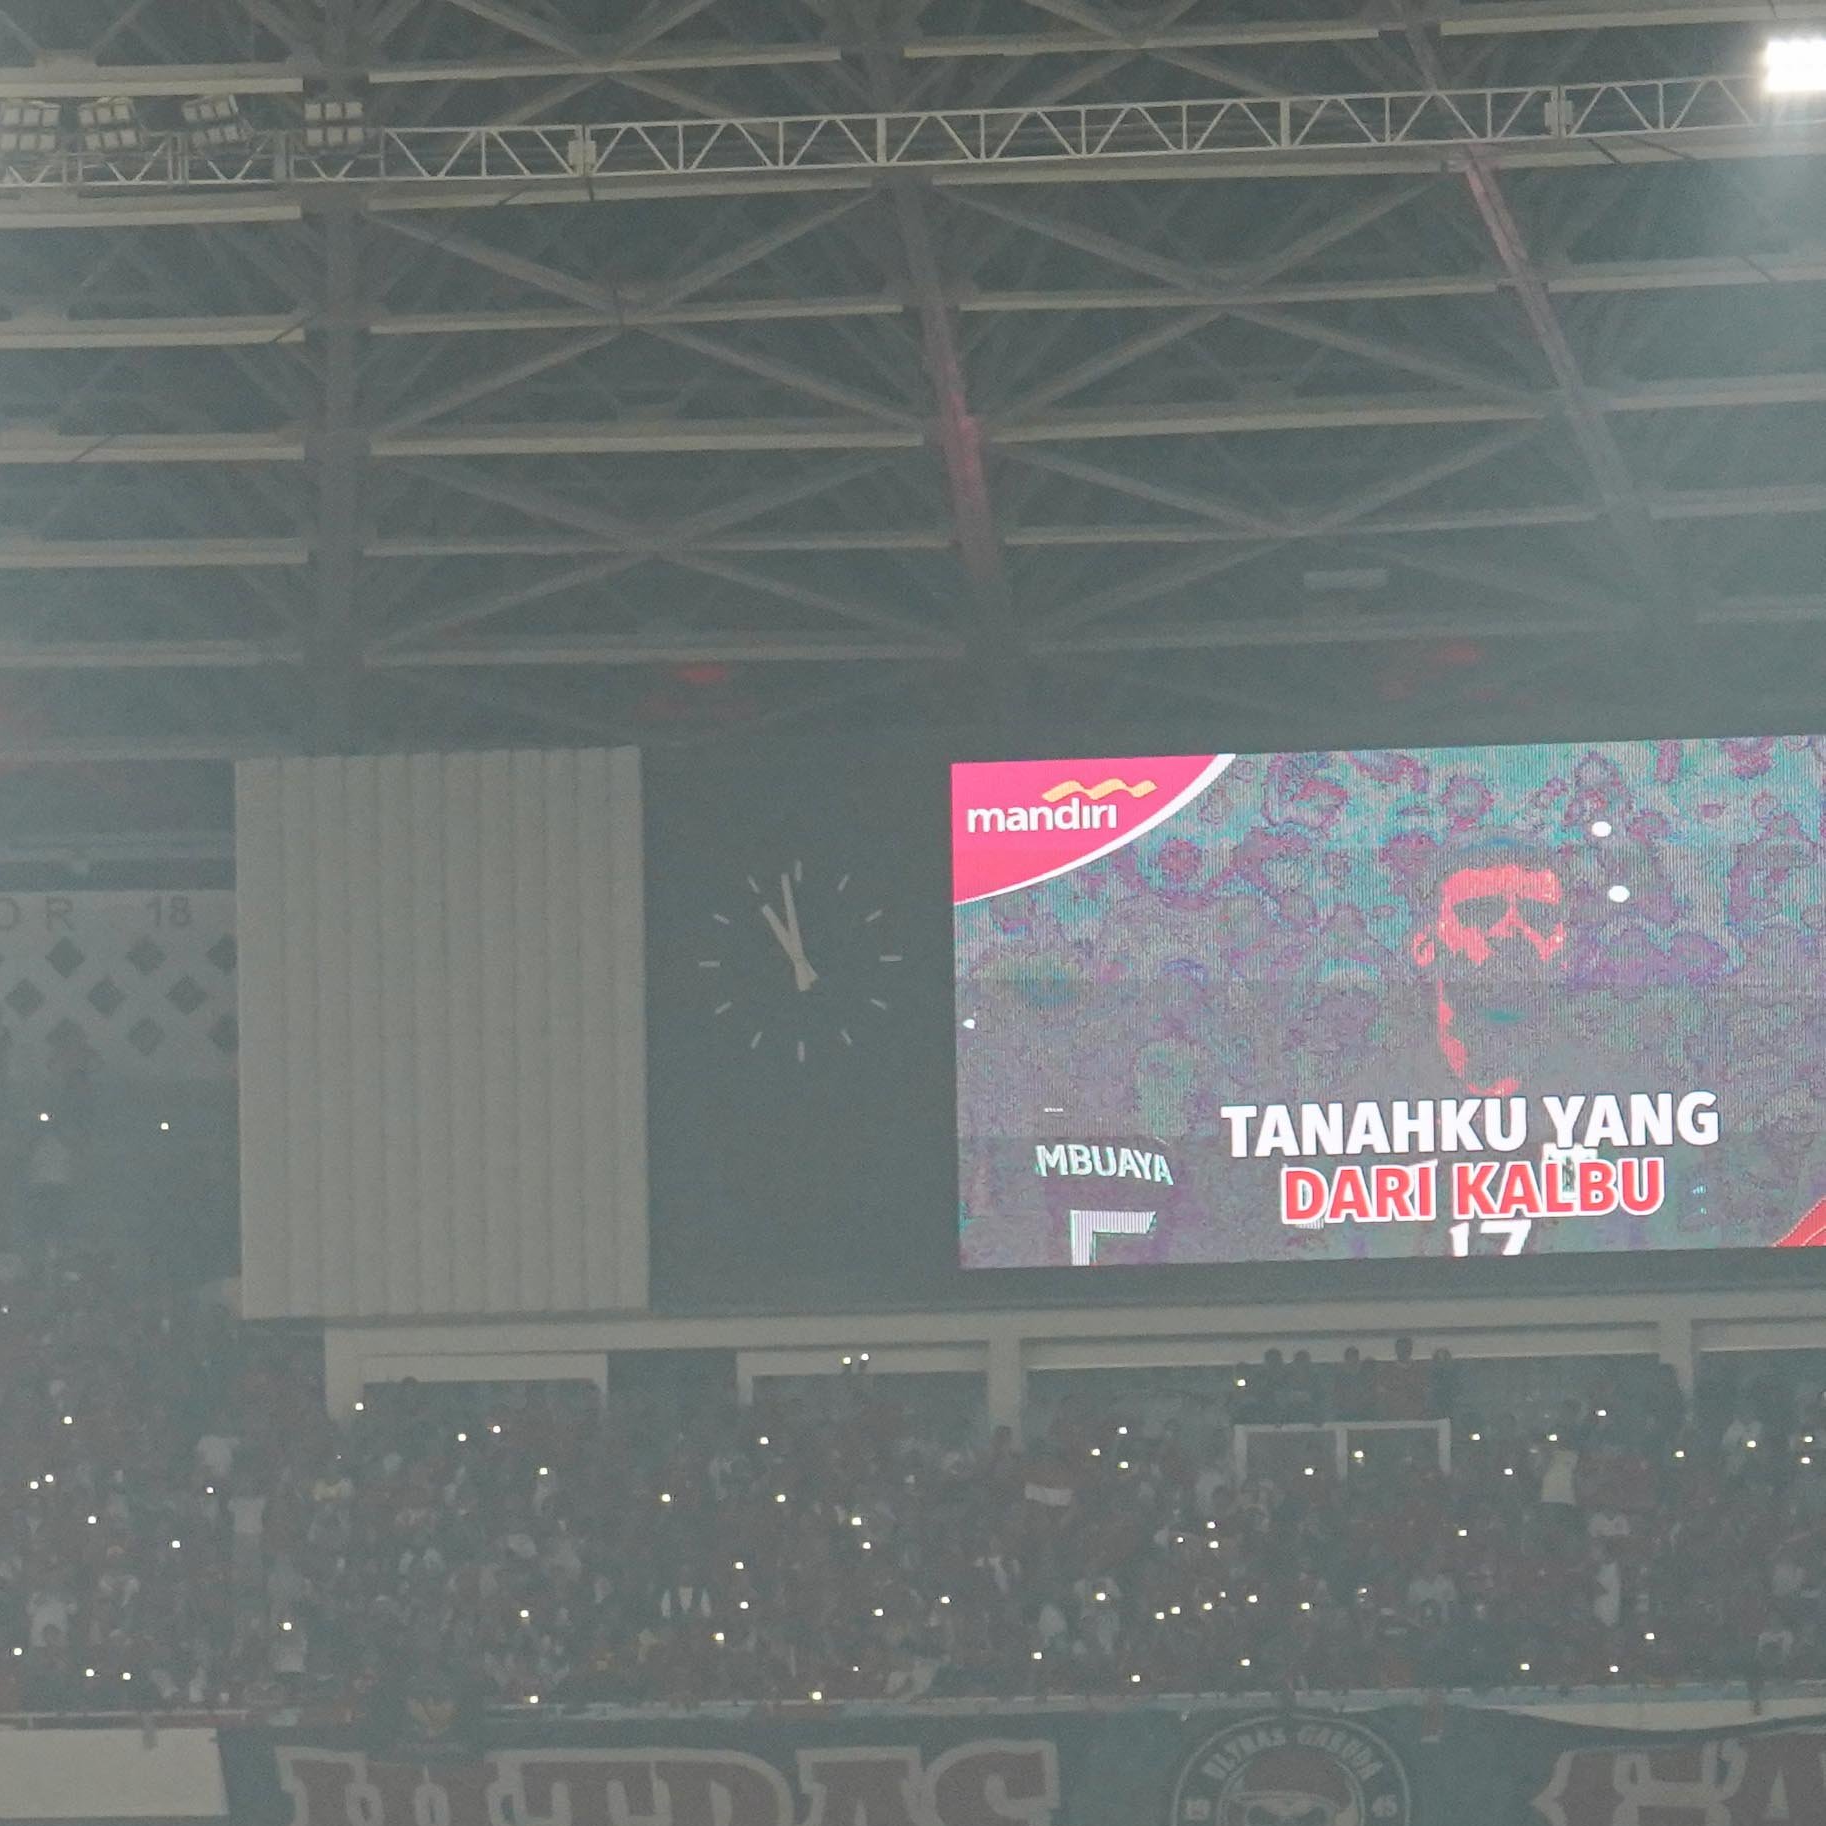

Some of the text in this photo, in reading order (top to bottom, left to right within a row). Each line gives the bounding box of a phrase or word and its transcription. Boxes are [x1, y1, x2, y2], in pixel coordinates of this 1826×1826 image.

[966, 796, 1117, 833] mandiri
[147, 896, 193, 930] 18
[1220, 1090, 1720, 1158] TANAHKU YANG
[1280, 1157, 1665, 1224] DARI KALBU
